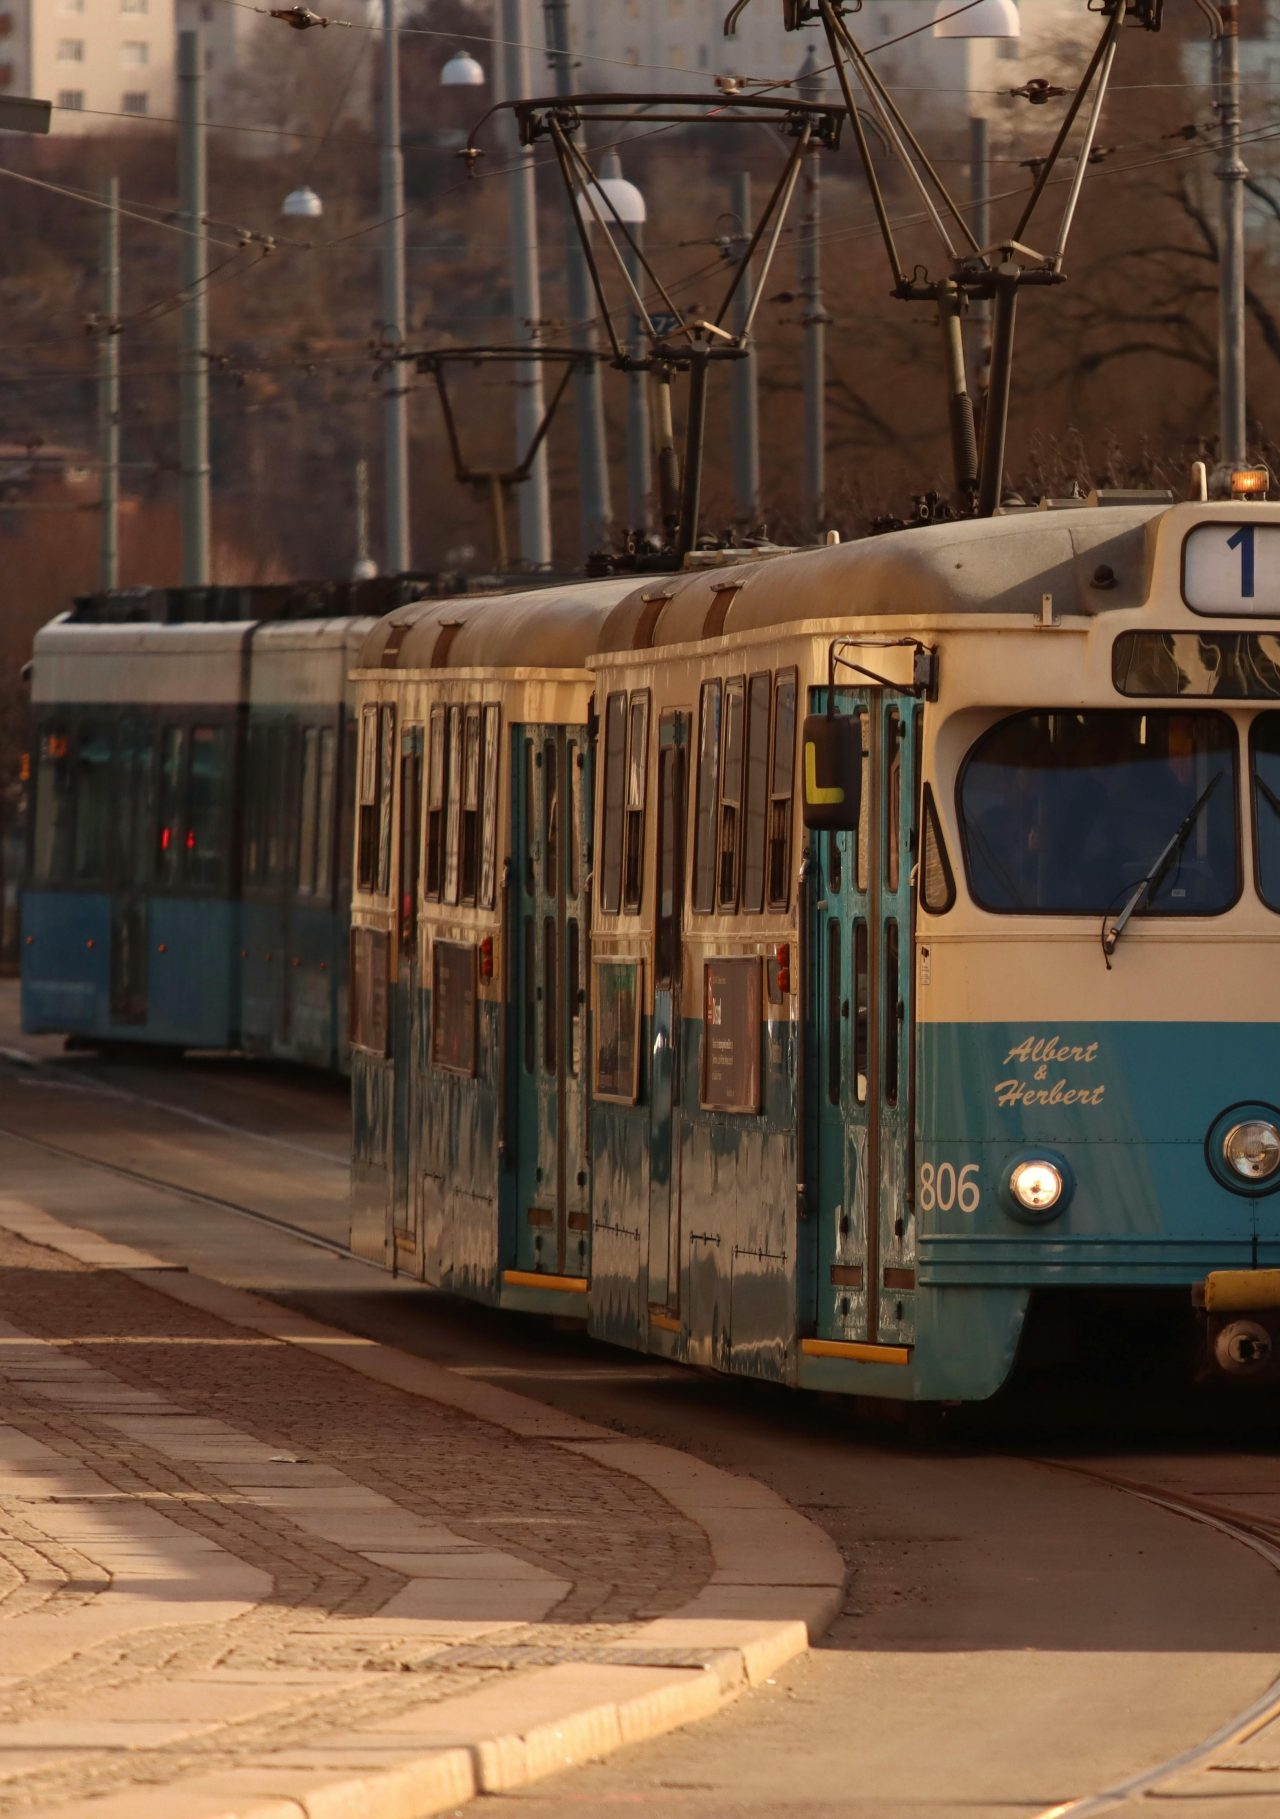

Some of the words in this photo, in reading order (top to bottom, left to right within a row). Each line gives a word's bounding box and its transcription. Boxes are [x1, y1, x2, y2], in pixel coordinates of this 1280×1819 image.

[1226, 526, 1254, 597] 1
[1003, 1036, 1098, 1064] Albert
[1034, 1065, 1047, 1080] &
[994, 1079, 1105, 1107] Herbert
[920, 1162, 980, 1213] 806
